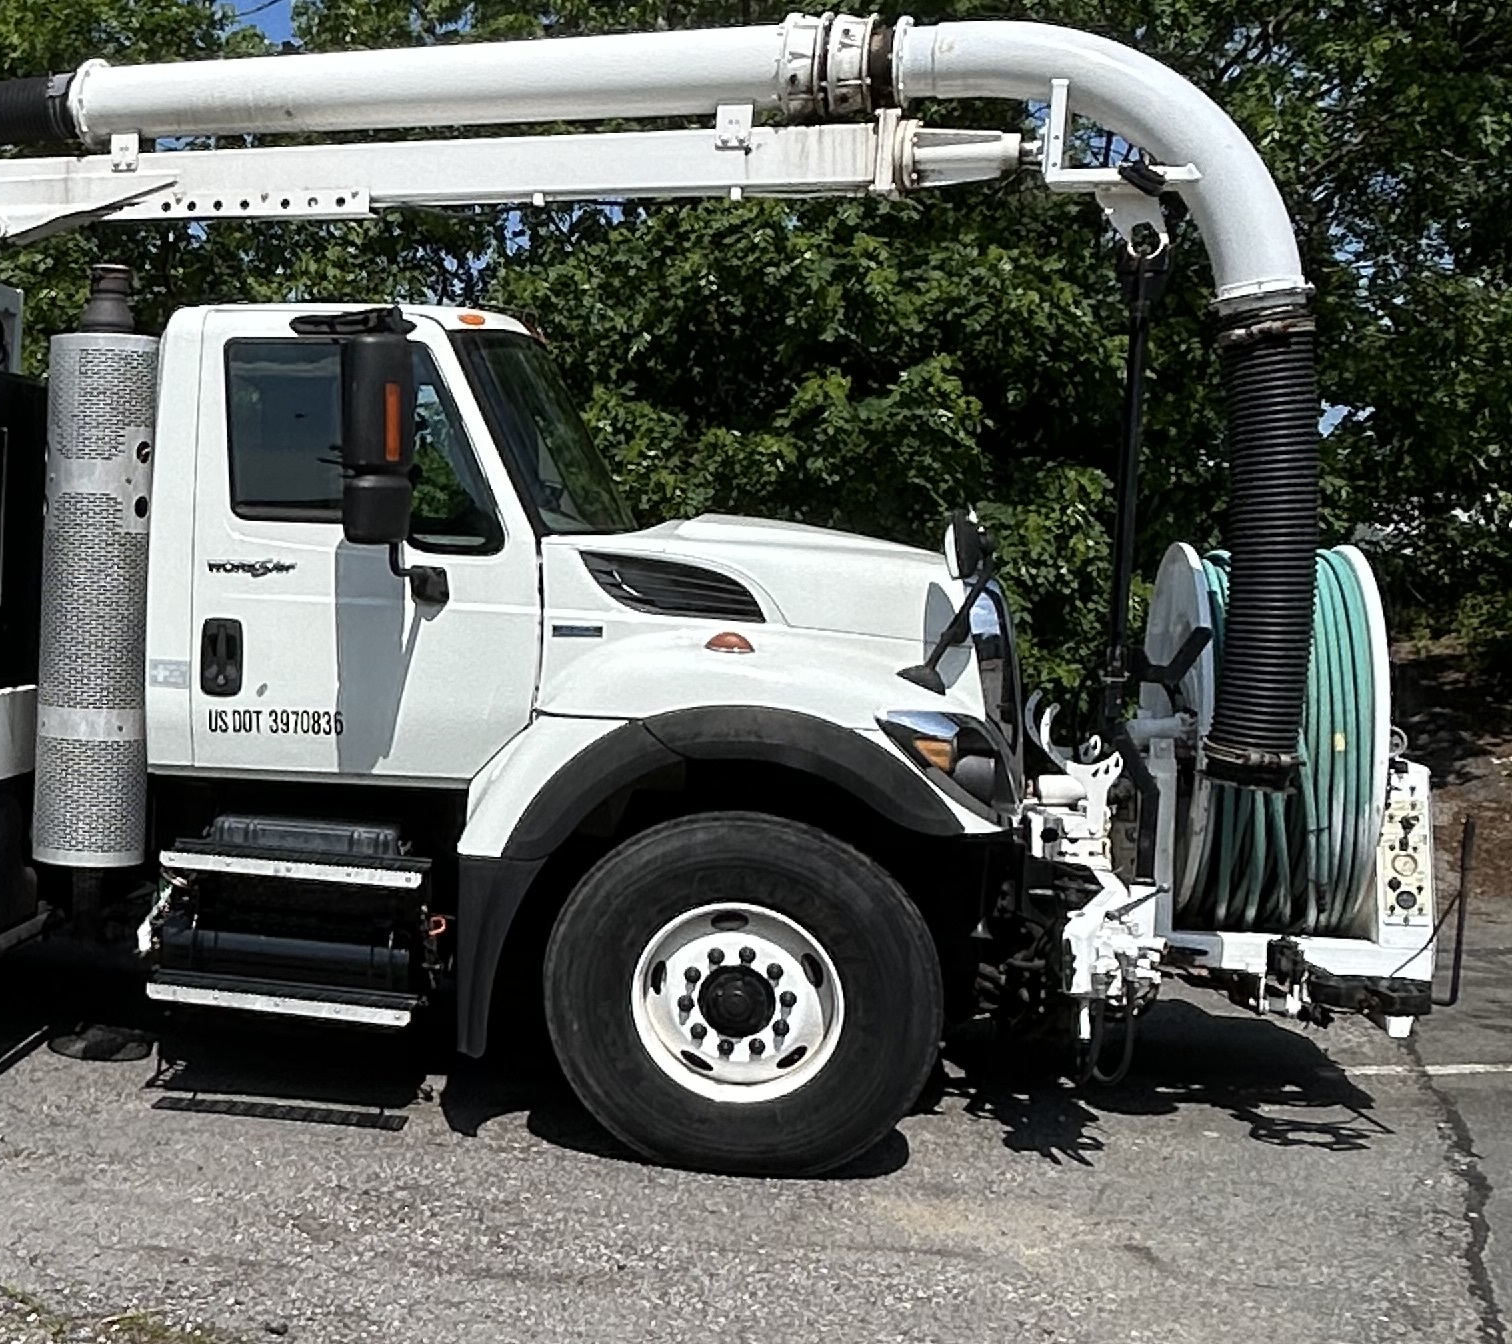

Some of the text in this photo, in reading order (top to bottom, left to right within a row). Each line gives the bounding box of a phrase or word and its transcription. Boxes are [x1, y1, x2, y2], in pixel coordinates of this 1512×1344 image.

[208, 708, 344, 735] US DOT 3970836
